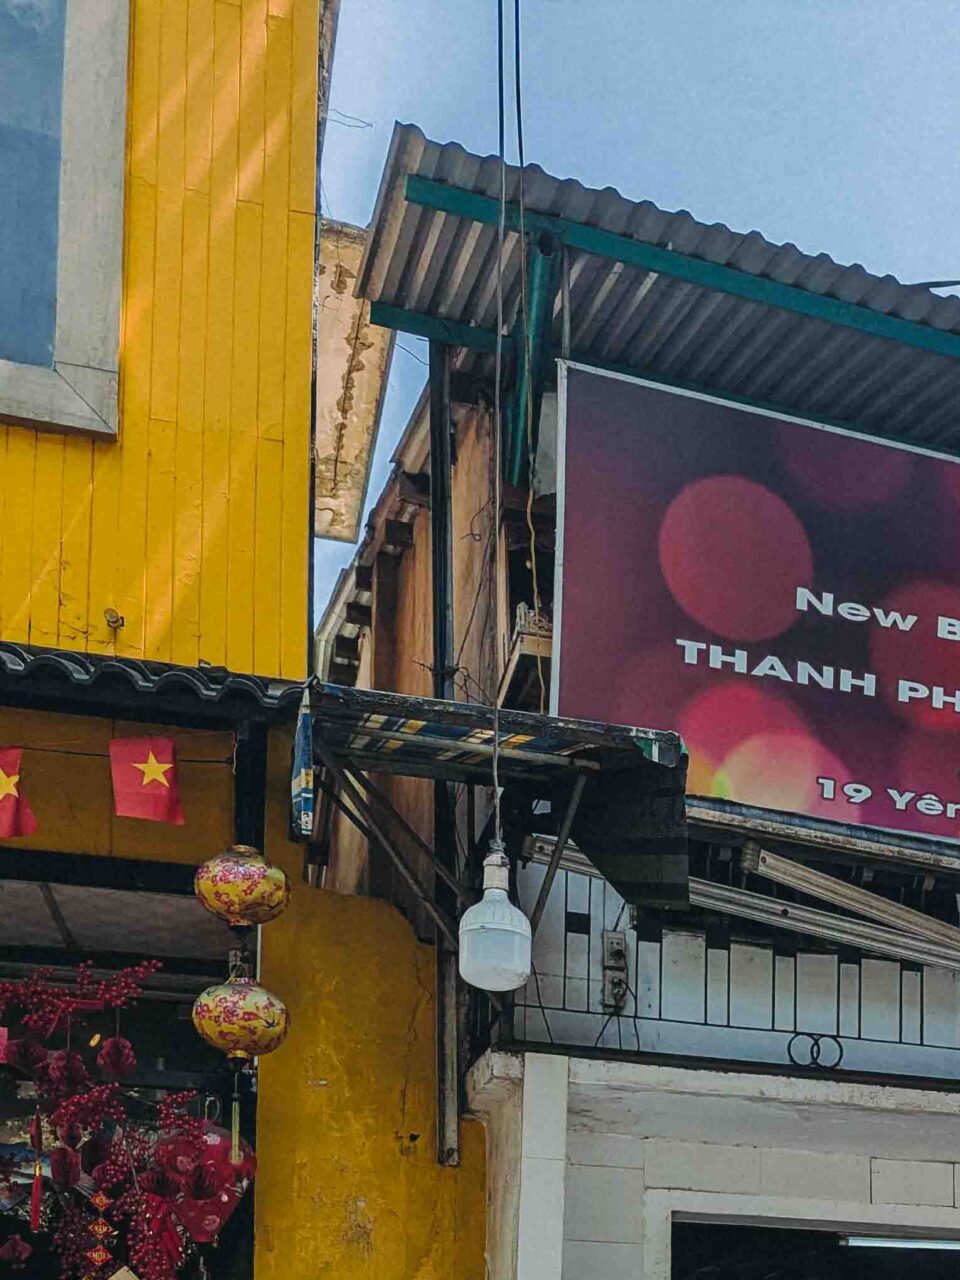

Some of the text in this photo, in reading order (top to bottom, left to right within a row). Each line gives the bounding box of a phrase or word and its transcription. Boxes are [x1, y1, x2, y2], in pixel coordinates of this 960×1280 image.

[795, 586, 918, 632] New
[676, 638, 877, 697] THANH
[817, 776, 872, 804] 19
